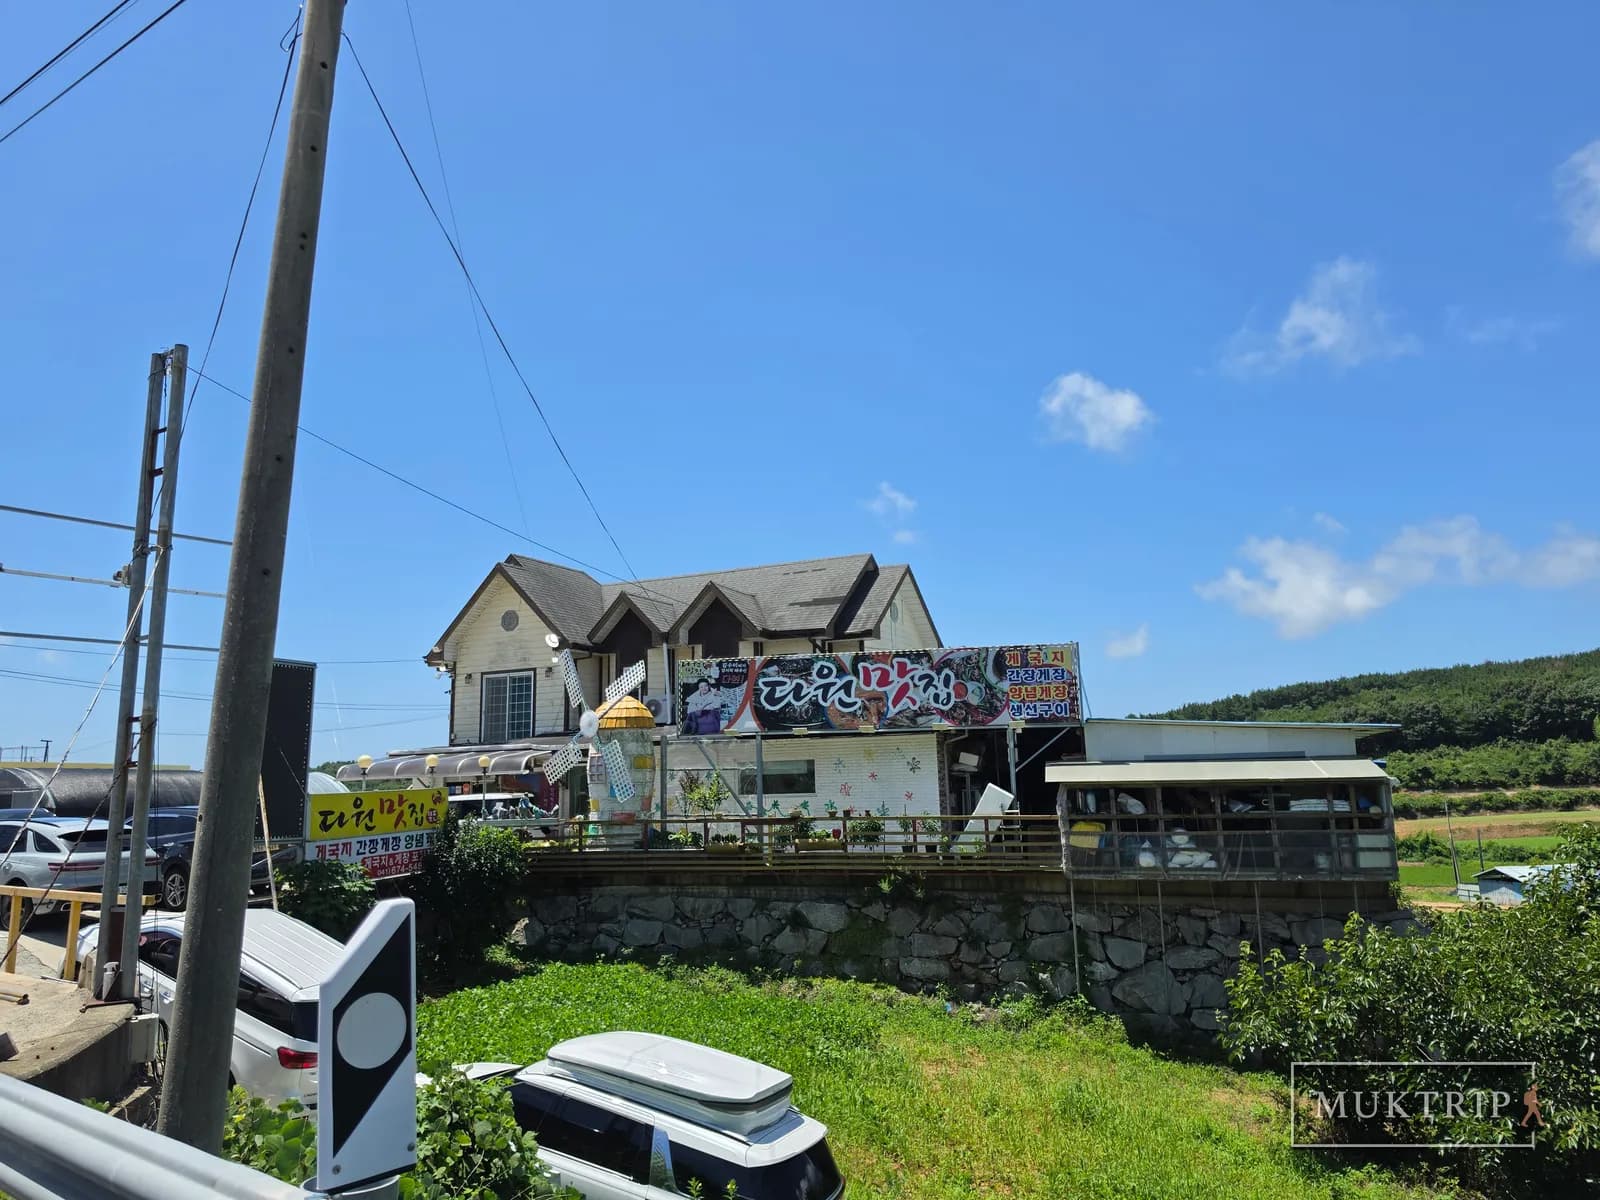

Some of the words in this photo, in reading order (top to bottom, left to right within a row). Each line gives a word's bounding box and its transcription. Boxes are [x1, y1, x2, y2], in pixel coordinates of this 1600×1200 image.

[1006, 650, 1065, 666] 게국지
[1007, 668, 1066, 682] 간장게장
[1009, 684, 1068, 700] 양념게장
[1010, 703, 1069, 717] 생선구이
[315, 841, 352, 860] 게국지
[356, 836, 402, 856] 간장게장
